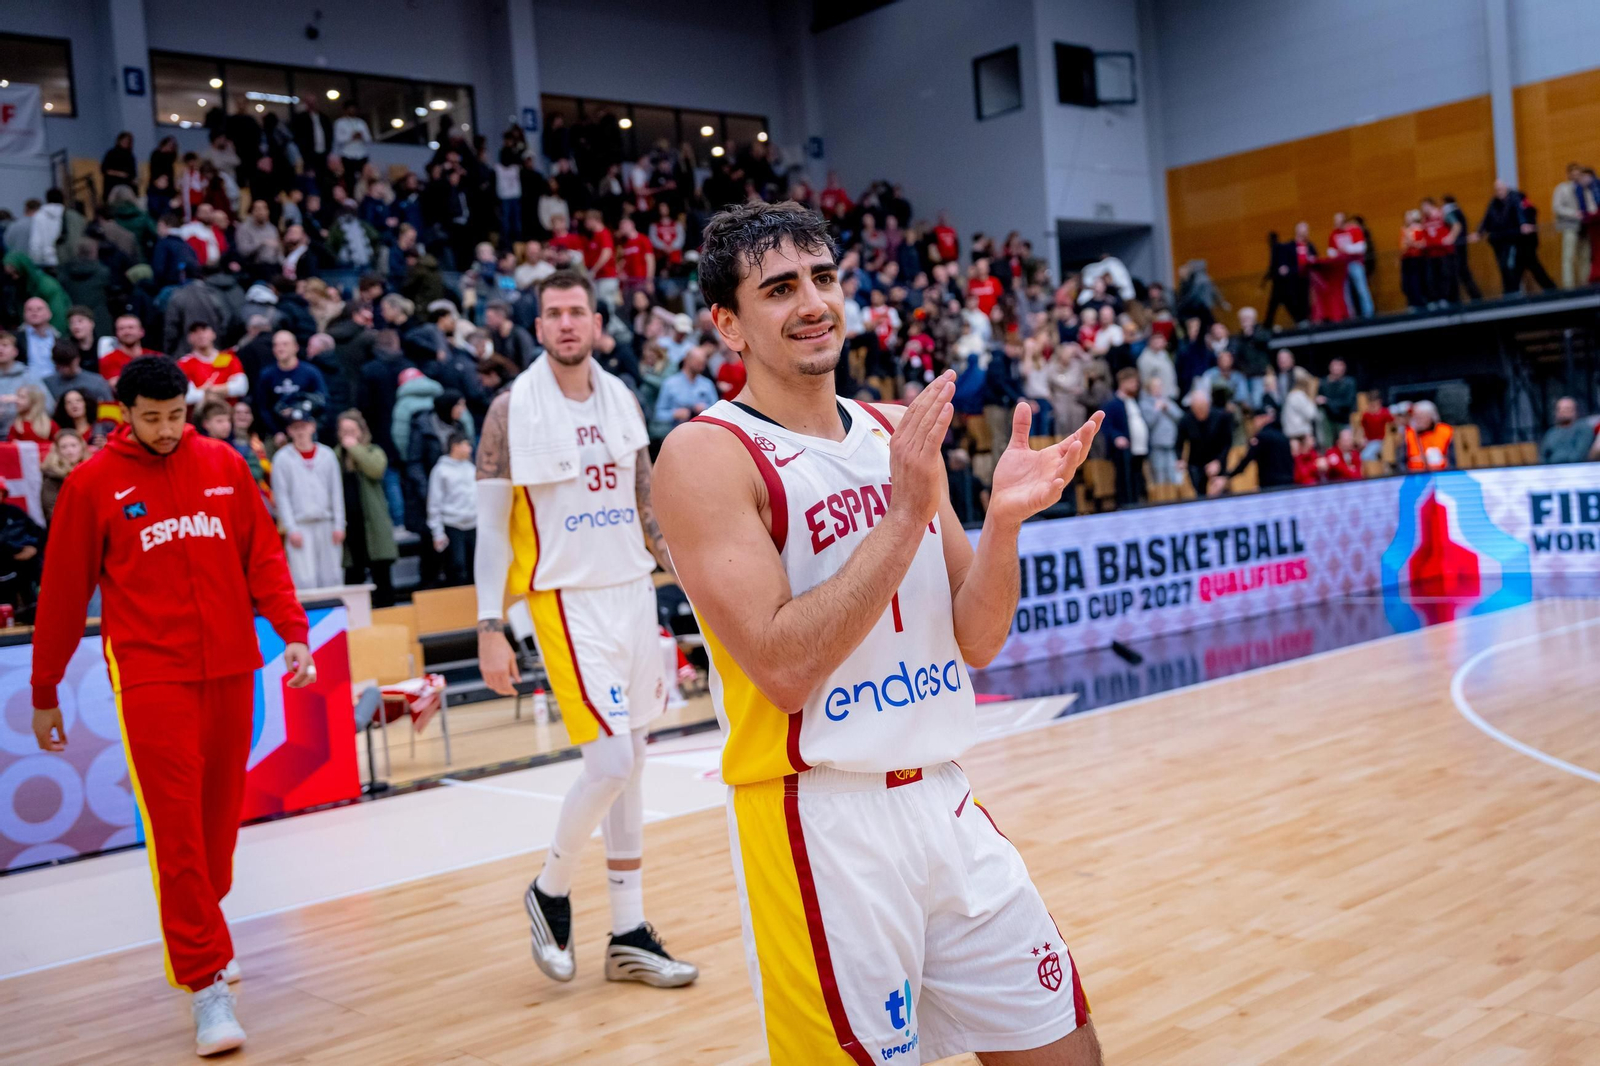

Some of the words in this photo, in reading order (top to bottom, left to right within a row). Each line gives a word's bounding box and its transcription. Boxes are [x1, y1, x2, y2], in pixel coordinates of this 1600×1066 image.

[1, 103, 17, 125] F
[585, 462, 617, 492] 35
[805, 476, 937, 555] ESPA
[1530, 491, 1600, 525] FIB
[140, 511, 226, 552] ESPAÑA
[1532, 532, 1600, 551] WOR
[1019, 553, 1085, 599] IBA
[1096, 518, 1305, 586] BASKETBALL
[1010, 600, 1080, 635] ORLD
[1088, 591, 1133, 619] CUP
[1140, 580, 1192, 611] 2027
[1199, 559, 1309, 602] QUALIFIERS
[825, 659, 962, 722] endesa
